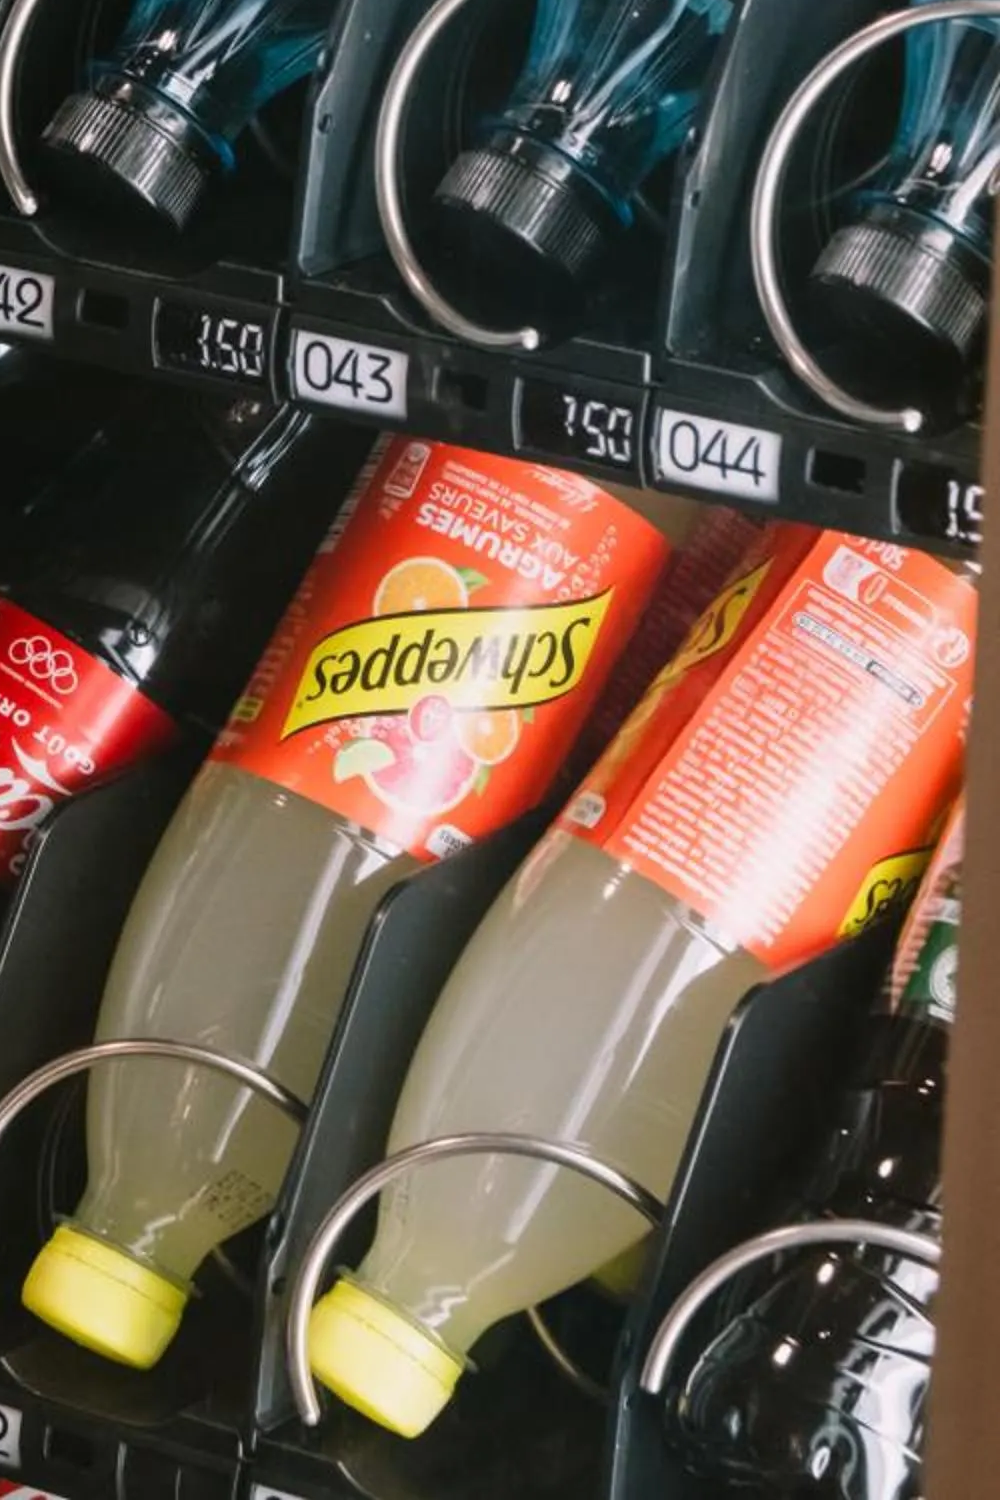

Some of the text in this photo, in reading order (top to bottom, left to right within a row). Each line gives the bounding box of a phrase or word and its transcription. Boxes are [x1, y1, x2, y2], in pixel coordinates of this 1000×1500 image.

[302, 340, 395, 404] 043
[668, 419, 767, 487] 044
[427, 481, 534, 543] SAVEURS
[415, 502, 564, 592] AGRUMES
[530, 531, 587, 572] AUX
[306, 617, 592, 702] Schweppes
